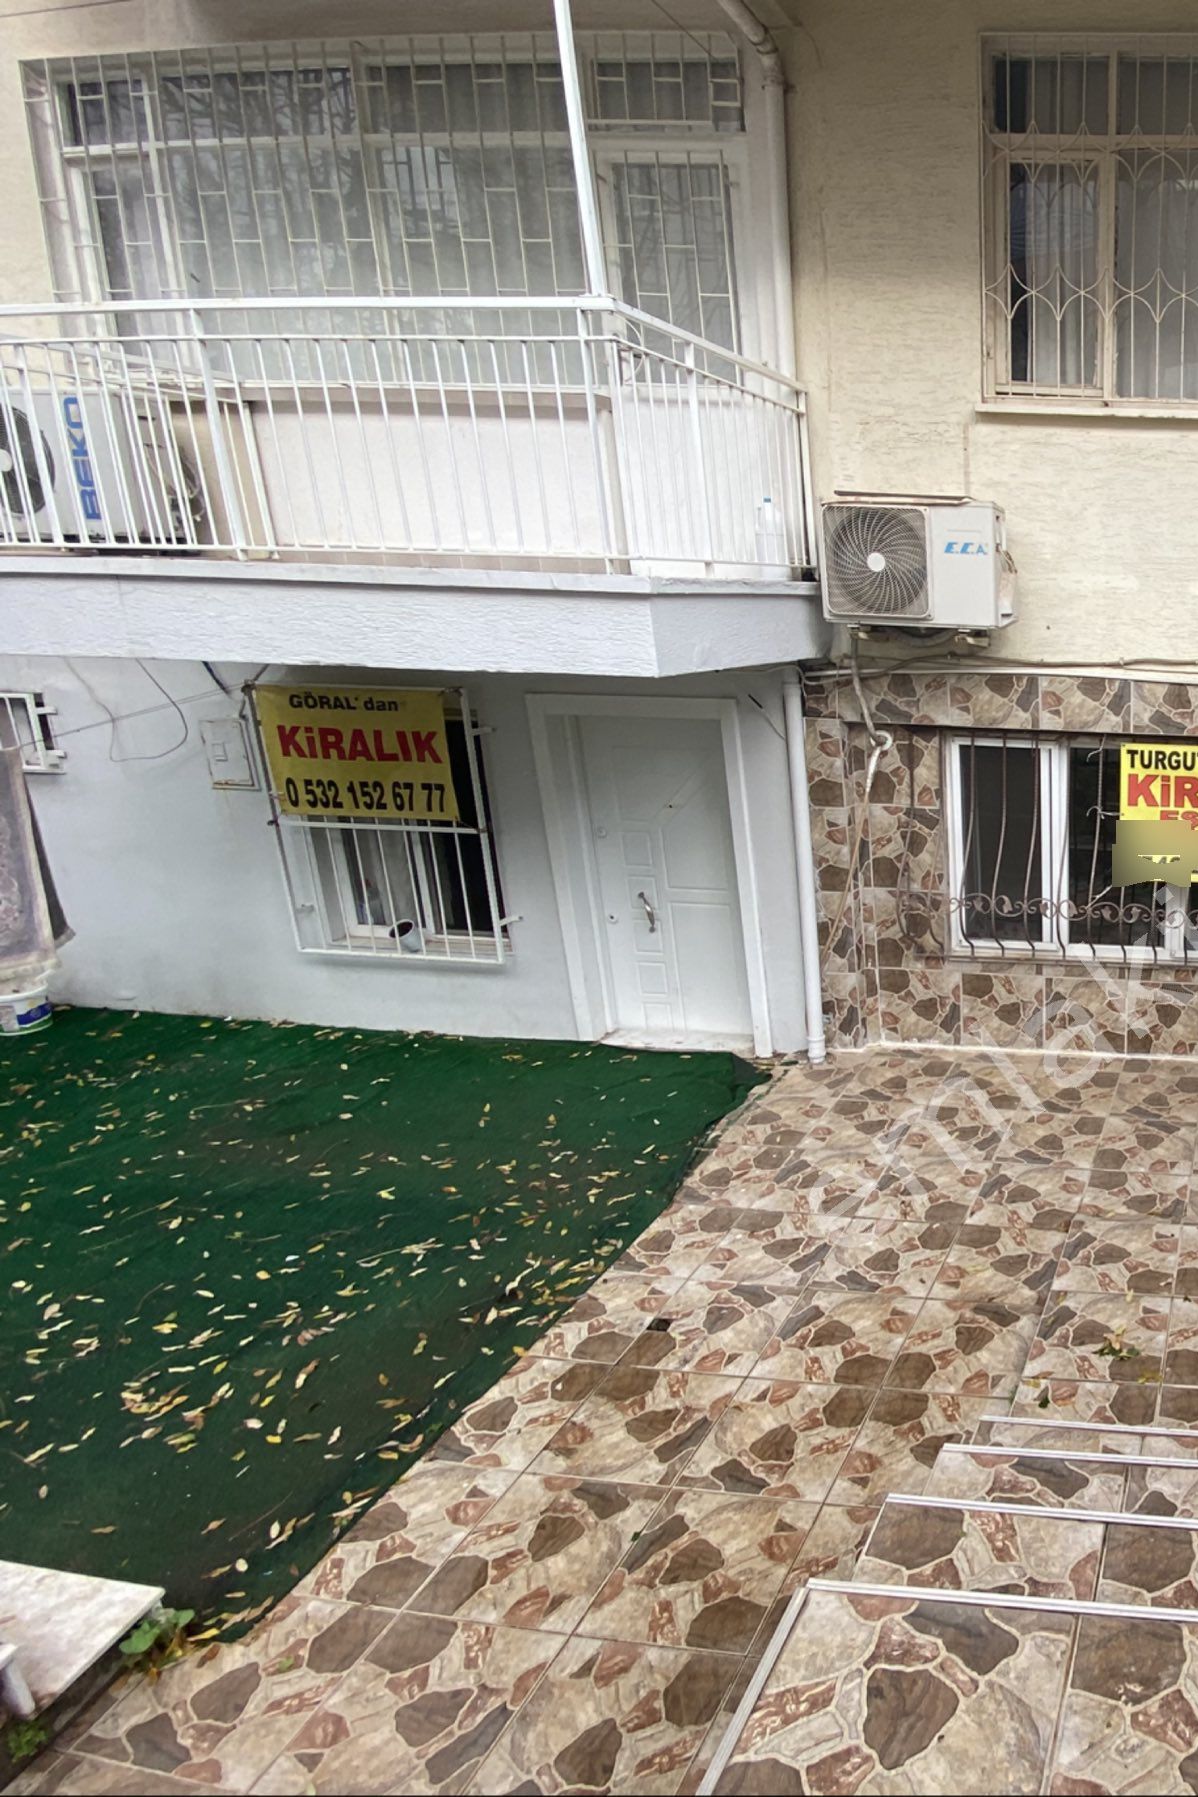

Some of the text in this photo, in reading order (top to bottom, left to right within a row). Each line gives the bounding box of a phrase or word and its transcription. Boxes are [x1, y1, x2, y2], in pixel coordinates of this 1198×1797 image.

[63, 396, 102, 520] BEKO
[285, 777, 445, 813] 0 532 152 67 77
